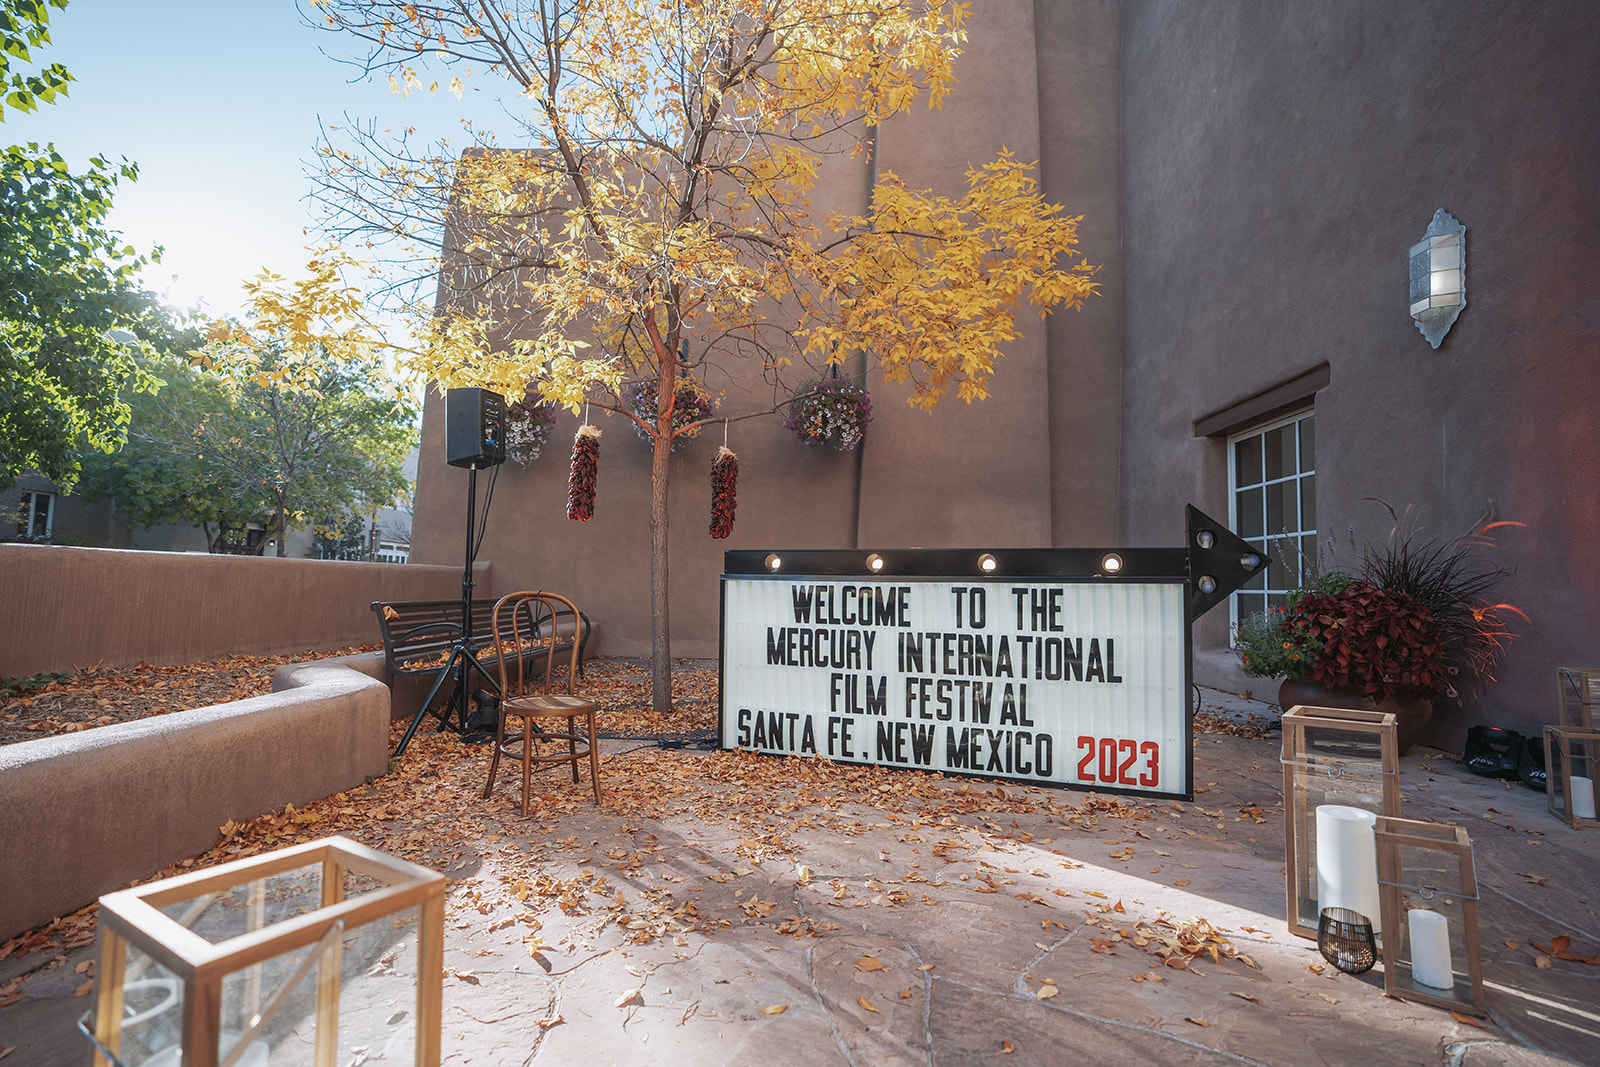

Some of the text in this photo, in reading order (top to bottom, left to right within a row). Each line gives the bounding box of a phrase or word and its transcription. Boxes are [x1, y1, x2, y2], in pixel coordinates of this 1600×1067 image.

[792, 585, 1064, 632] WELCOME TO THE
[767, 627, 1122, 683] MERCURY INTERNATIONAL
[831, 673, 1034, 727] FILM FESTIVAL
[737, 708, 816, 754] SANTA
[877, 721, 936, 765] NEW
[947, 727, 1053, 777] MEXICO
[1077, 736, 1159, 787] 2023
